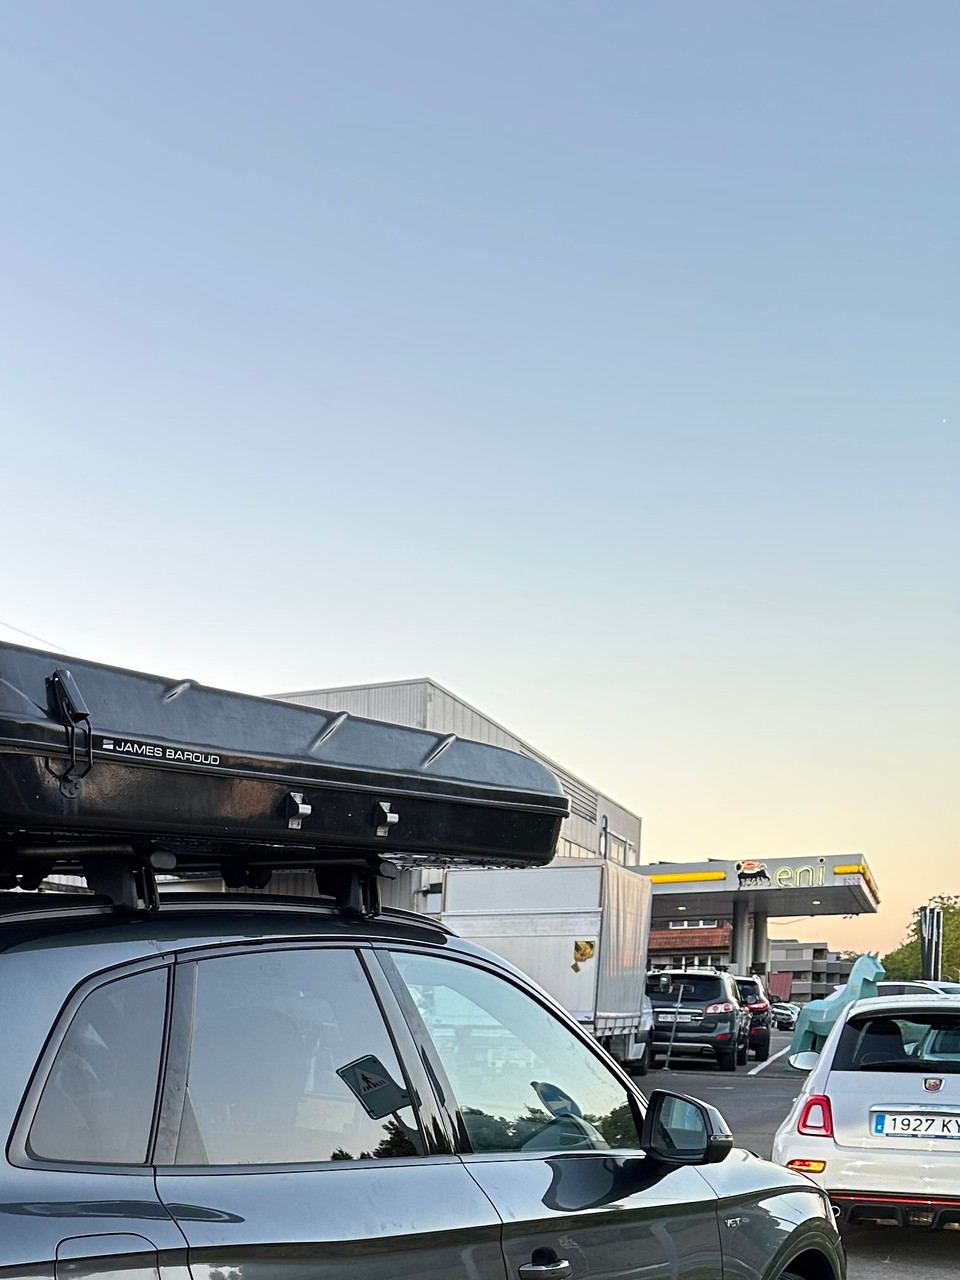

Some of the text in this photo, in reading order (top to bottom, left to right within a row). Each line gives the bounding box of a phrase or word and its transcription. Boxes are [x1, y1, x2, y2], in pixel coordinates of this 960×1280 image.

[116, 742, 220, 765] JAMES BAROUD
[774, 857, 826, 887] eni
[892, 1117, 936, 1132] 1927
